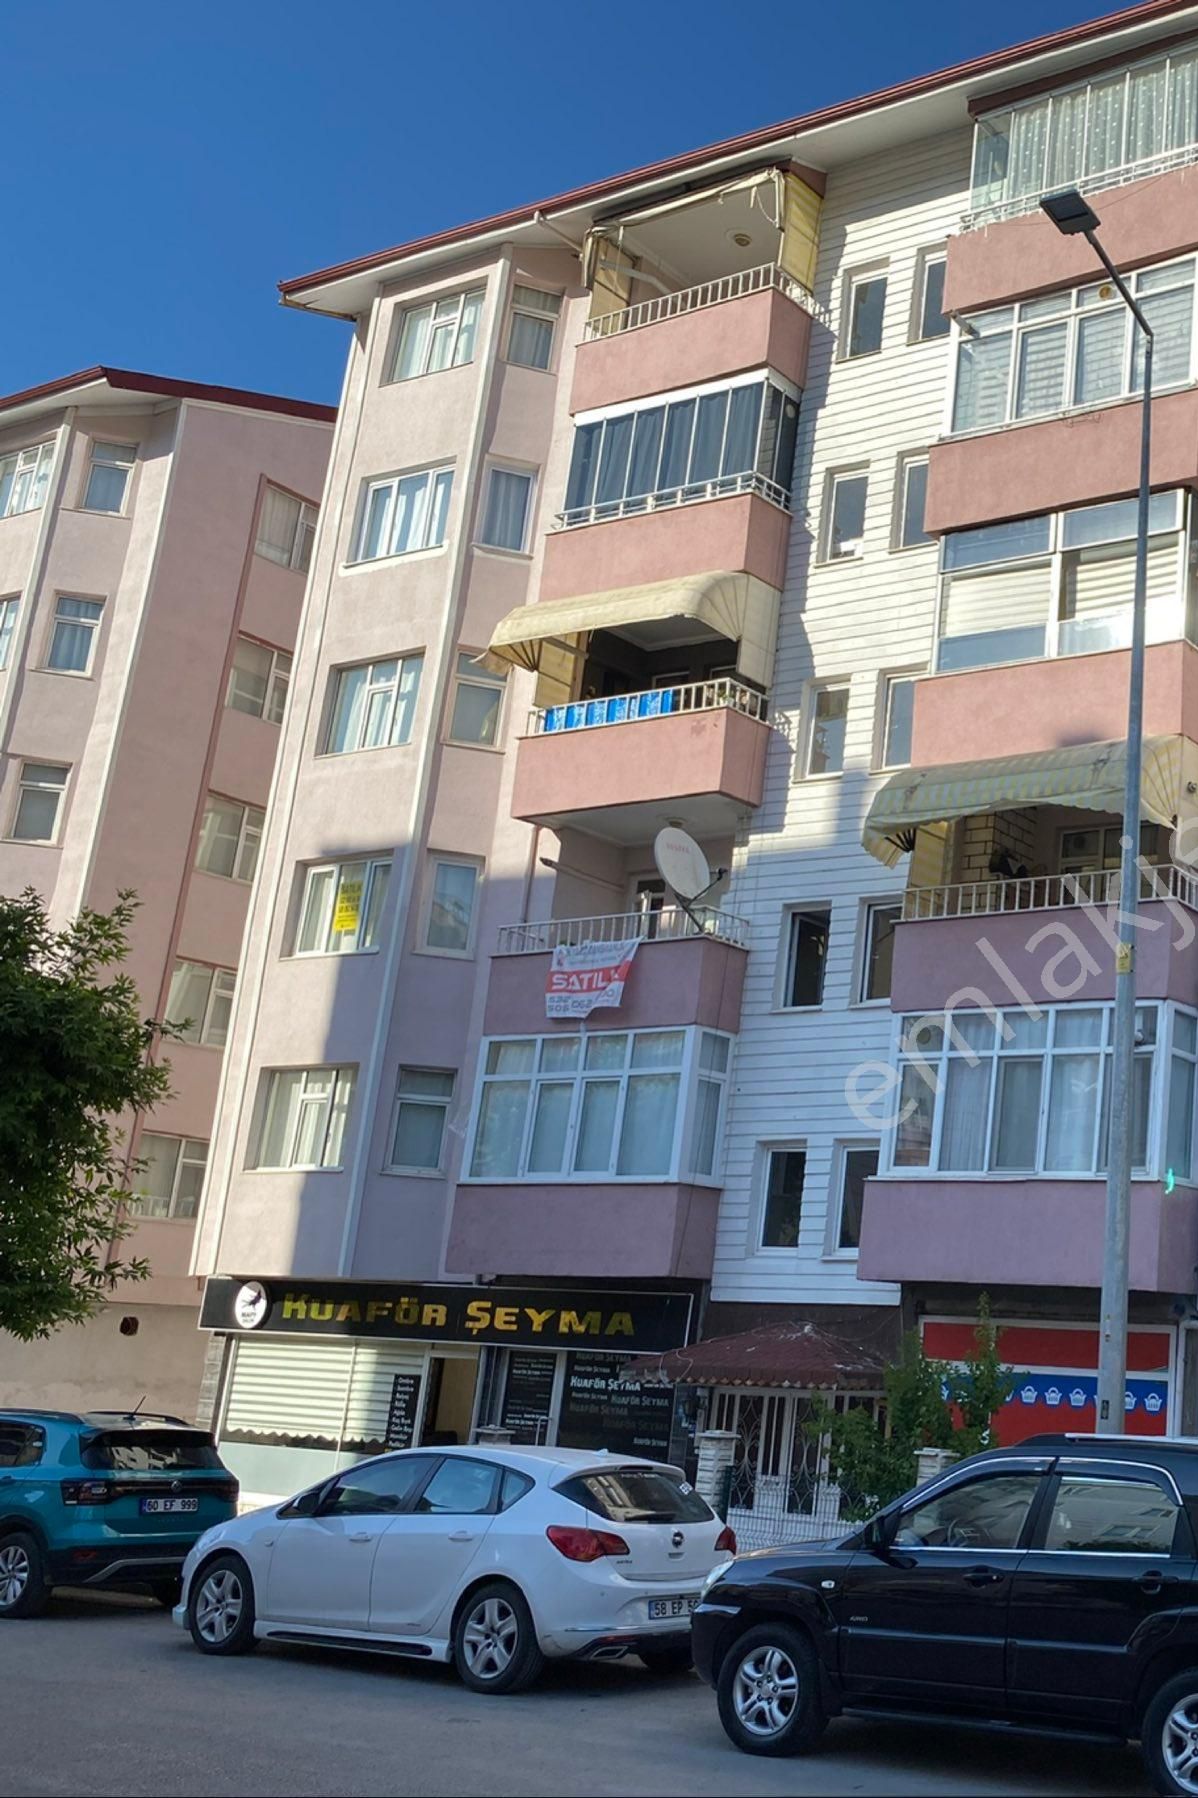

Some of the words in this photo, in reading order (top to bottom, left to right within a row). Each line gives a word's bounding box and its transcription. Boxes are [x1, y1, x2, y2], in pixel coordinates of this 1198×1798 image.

[282, 1293, 447, 1327] KUAFÖR
[465, 1300, 635, 1336] ŞEYMA
[570, 1376, 606, 1389] KUAFÖR
[607, 1379, 641, 1392] ŞEYMA
[147, 1500, 158, 1511] 60
[164, 1500, 175, 1511] EF
[181, 1499, 197, 1511] 999
[655, 1601, 666, 1616] 58
[671, 1601, 683, 1615] EP
